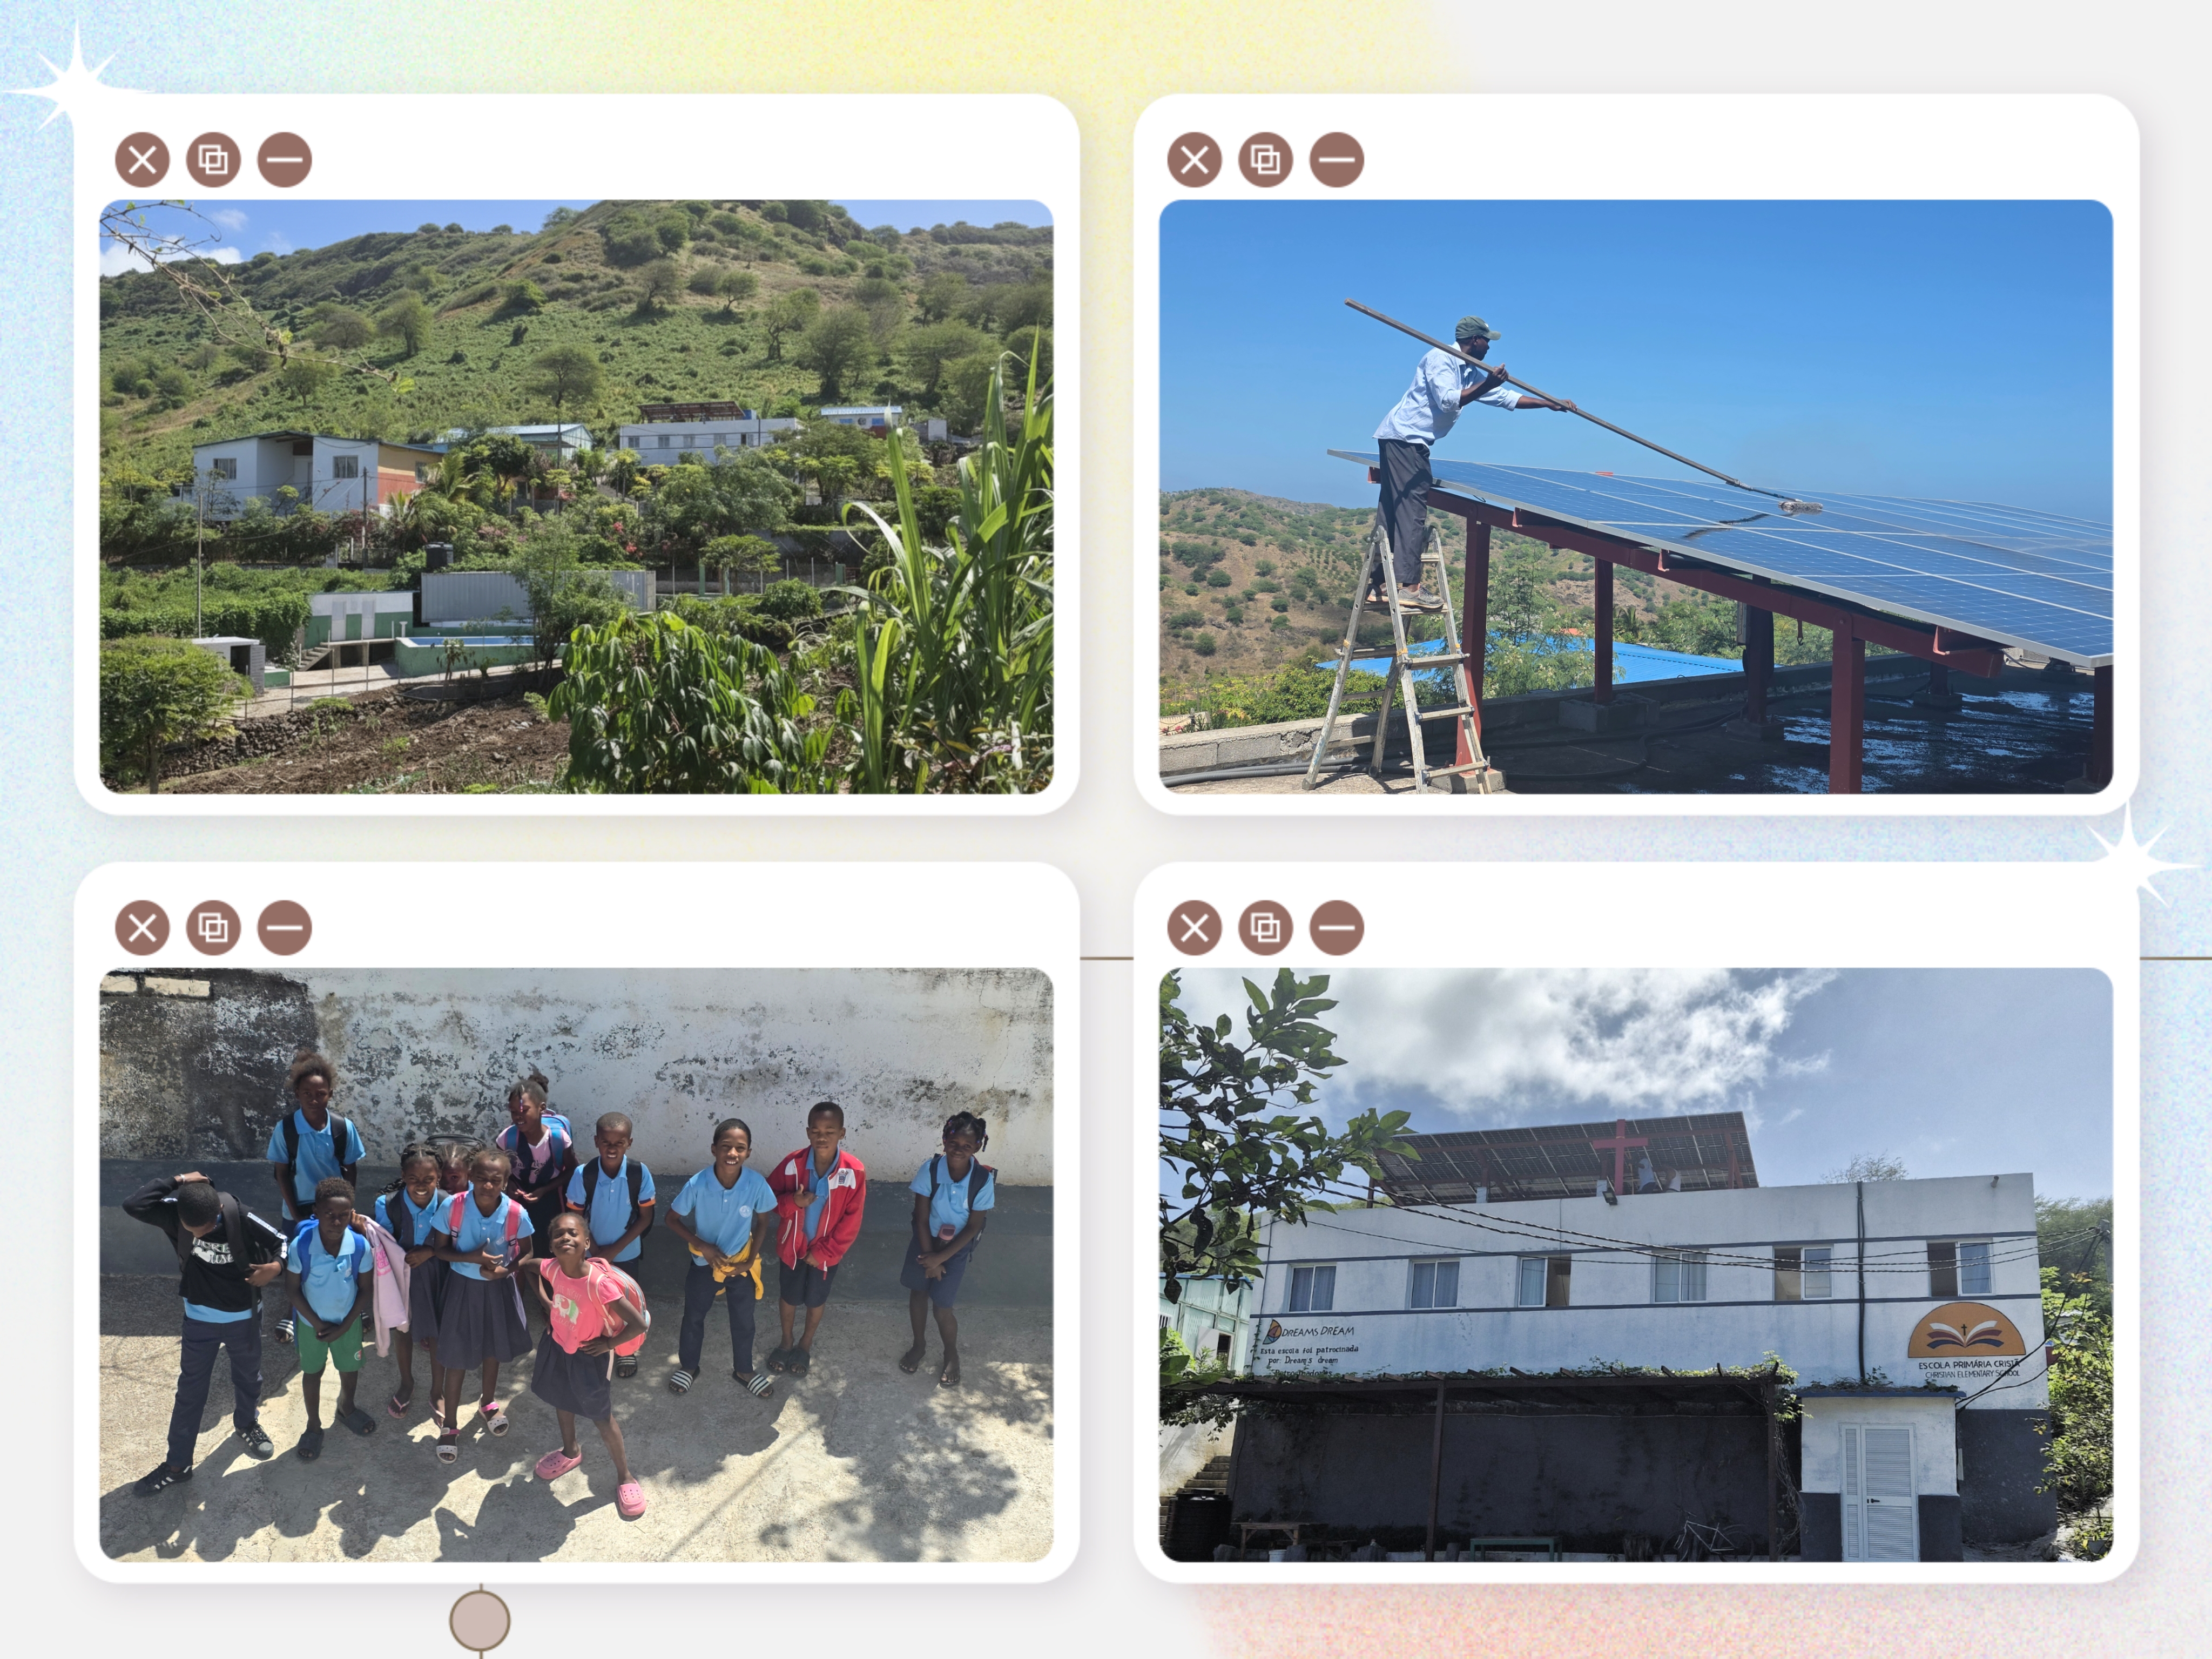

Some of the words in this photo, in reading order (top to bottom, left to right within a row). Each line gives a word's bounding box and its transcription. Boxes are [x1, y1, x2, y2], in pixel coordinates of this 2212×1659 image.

[1282, 1327, 1318, 1337] DREAMS
[1320, 1326, 1354, 1336] DREAM
[1316, 1345, 1359, 1355] patrocinada
[1919, 1361, 1951, 1370] ESCOLA
[1953, 1359, 1992, 1369] PRIMÁRIA
[1994, 1358, 2020, 1367] CRISTÃ
